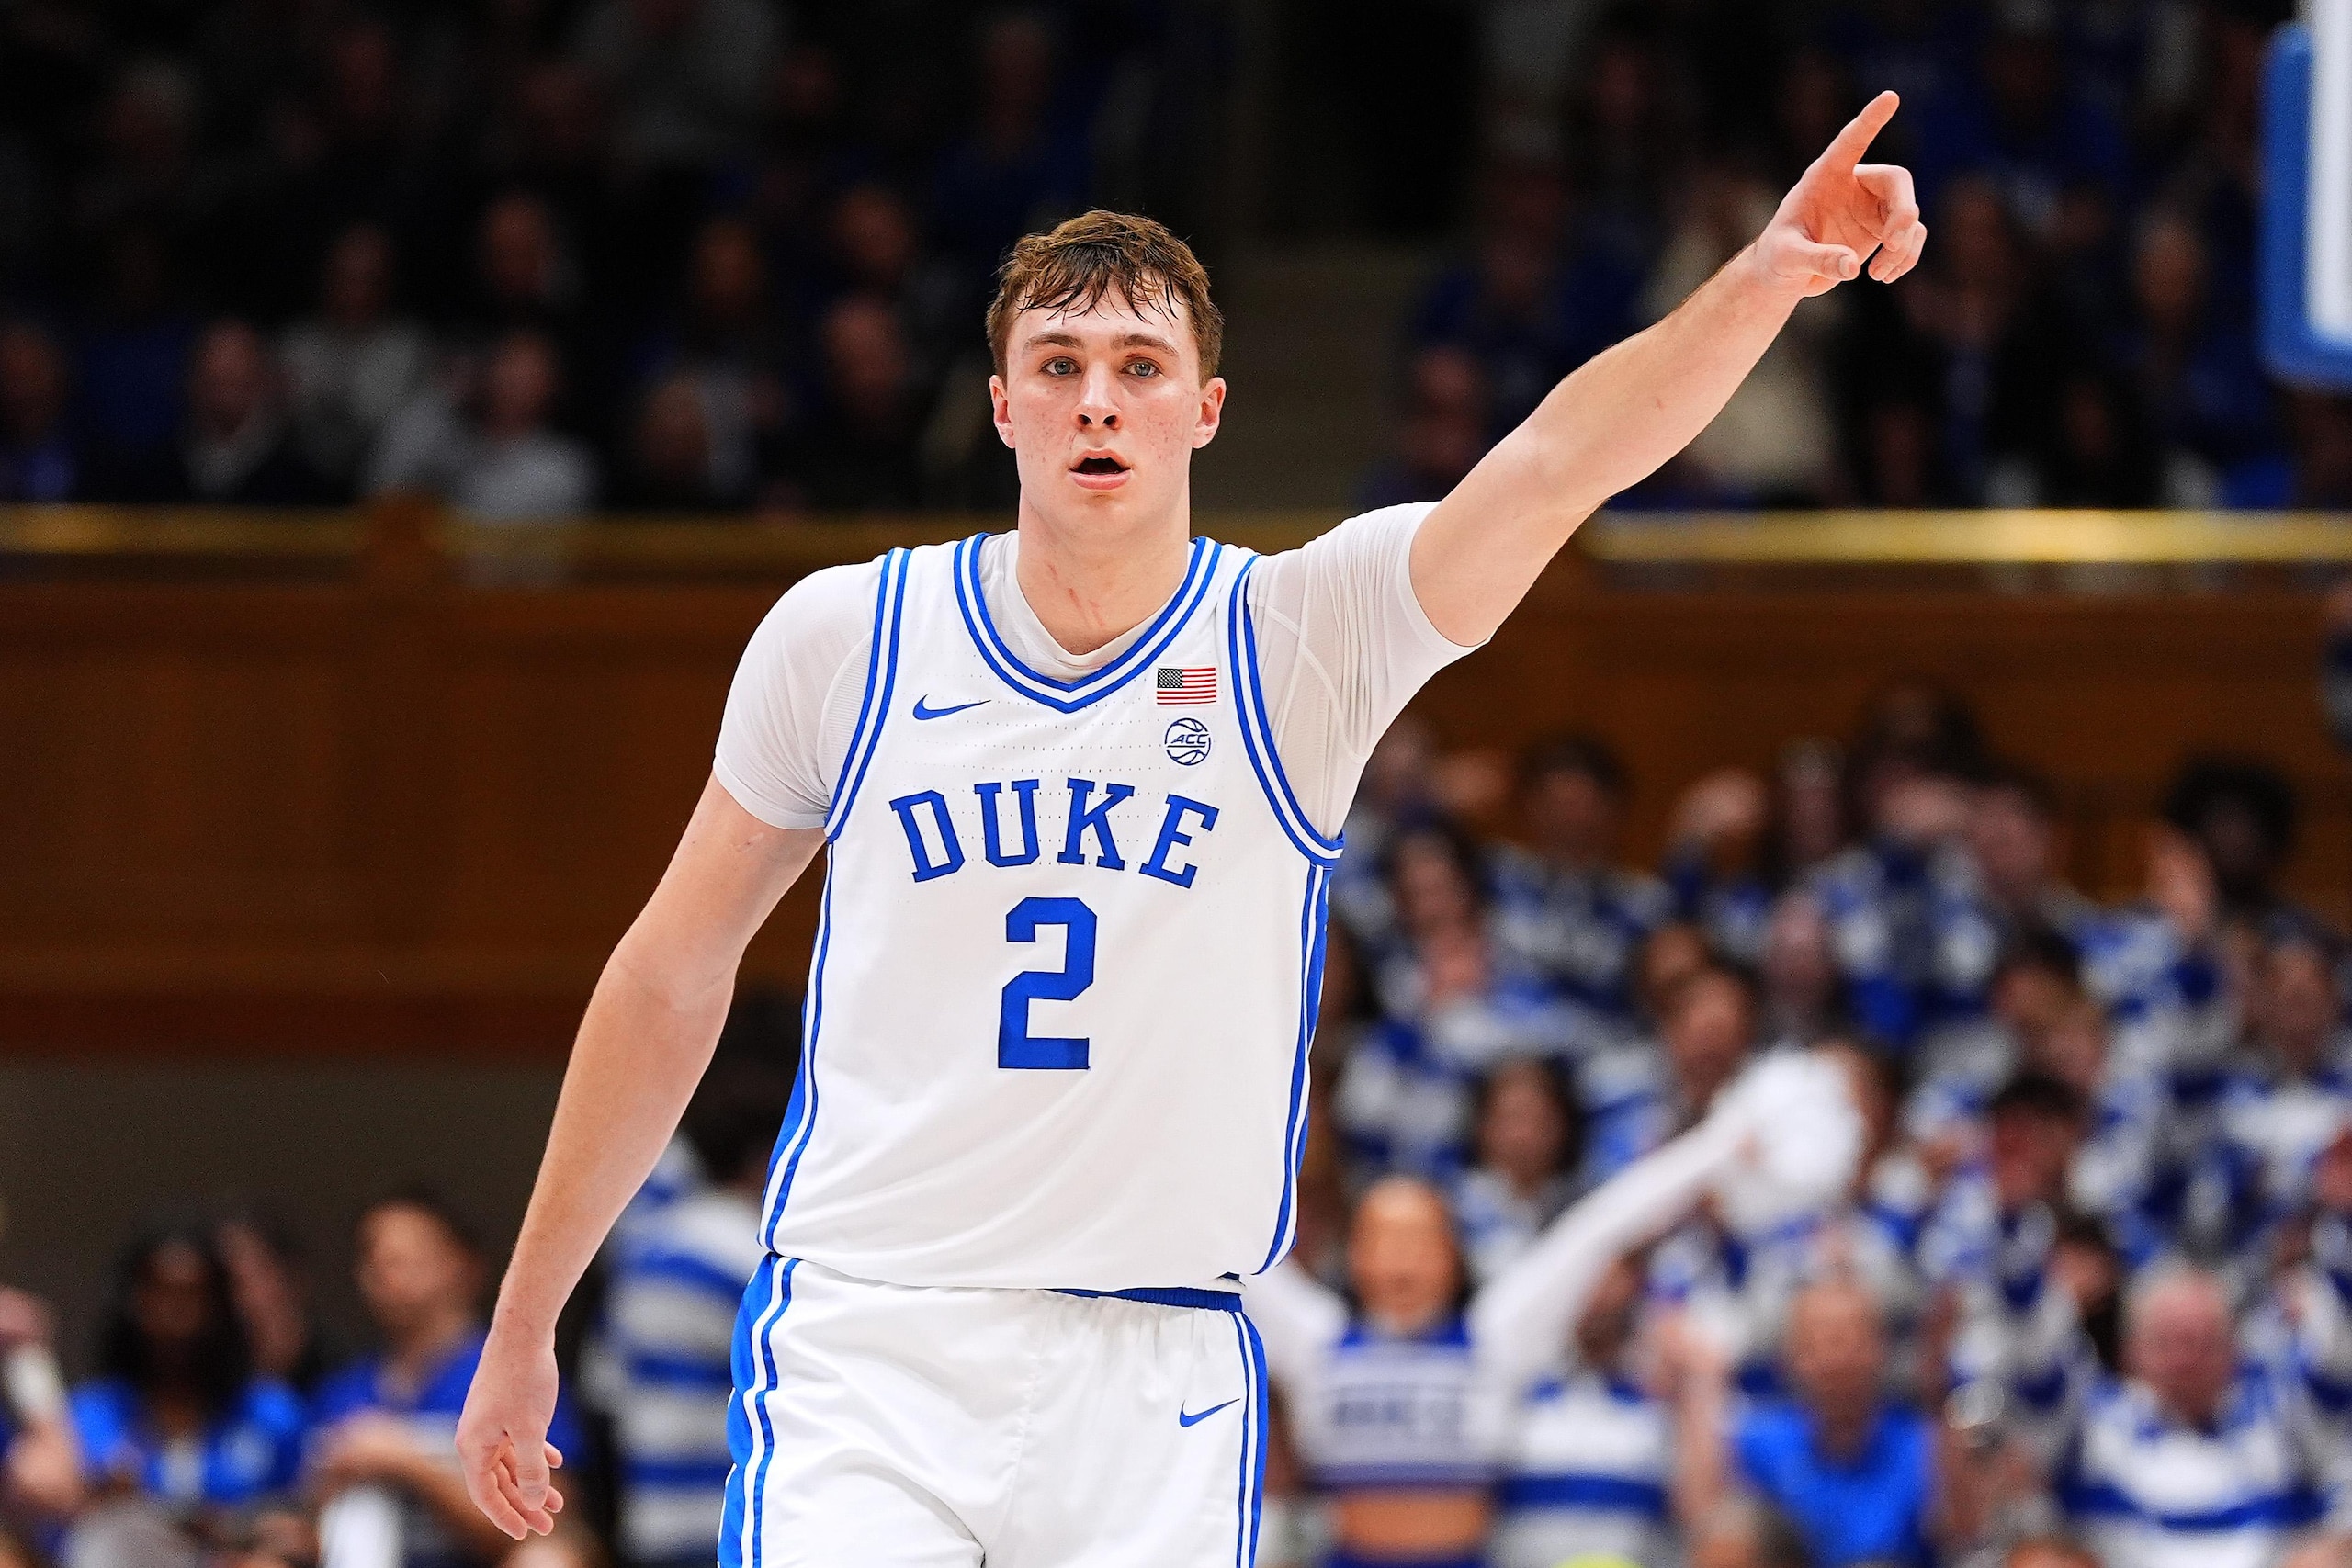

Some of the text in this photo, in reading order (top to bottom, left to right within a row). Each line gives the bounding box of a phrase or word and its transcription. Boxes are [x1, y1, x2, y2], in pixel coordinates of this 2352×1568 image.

[1170, 733, 1209, 745] ACC
[889, 778, 1219, 888] DUKE
[998, 897, 1098, 1070] 2
